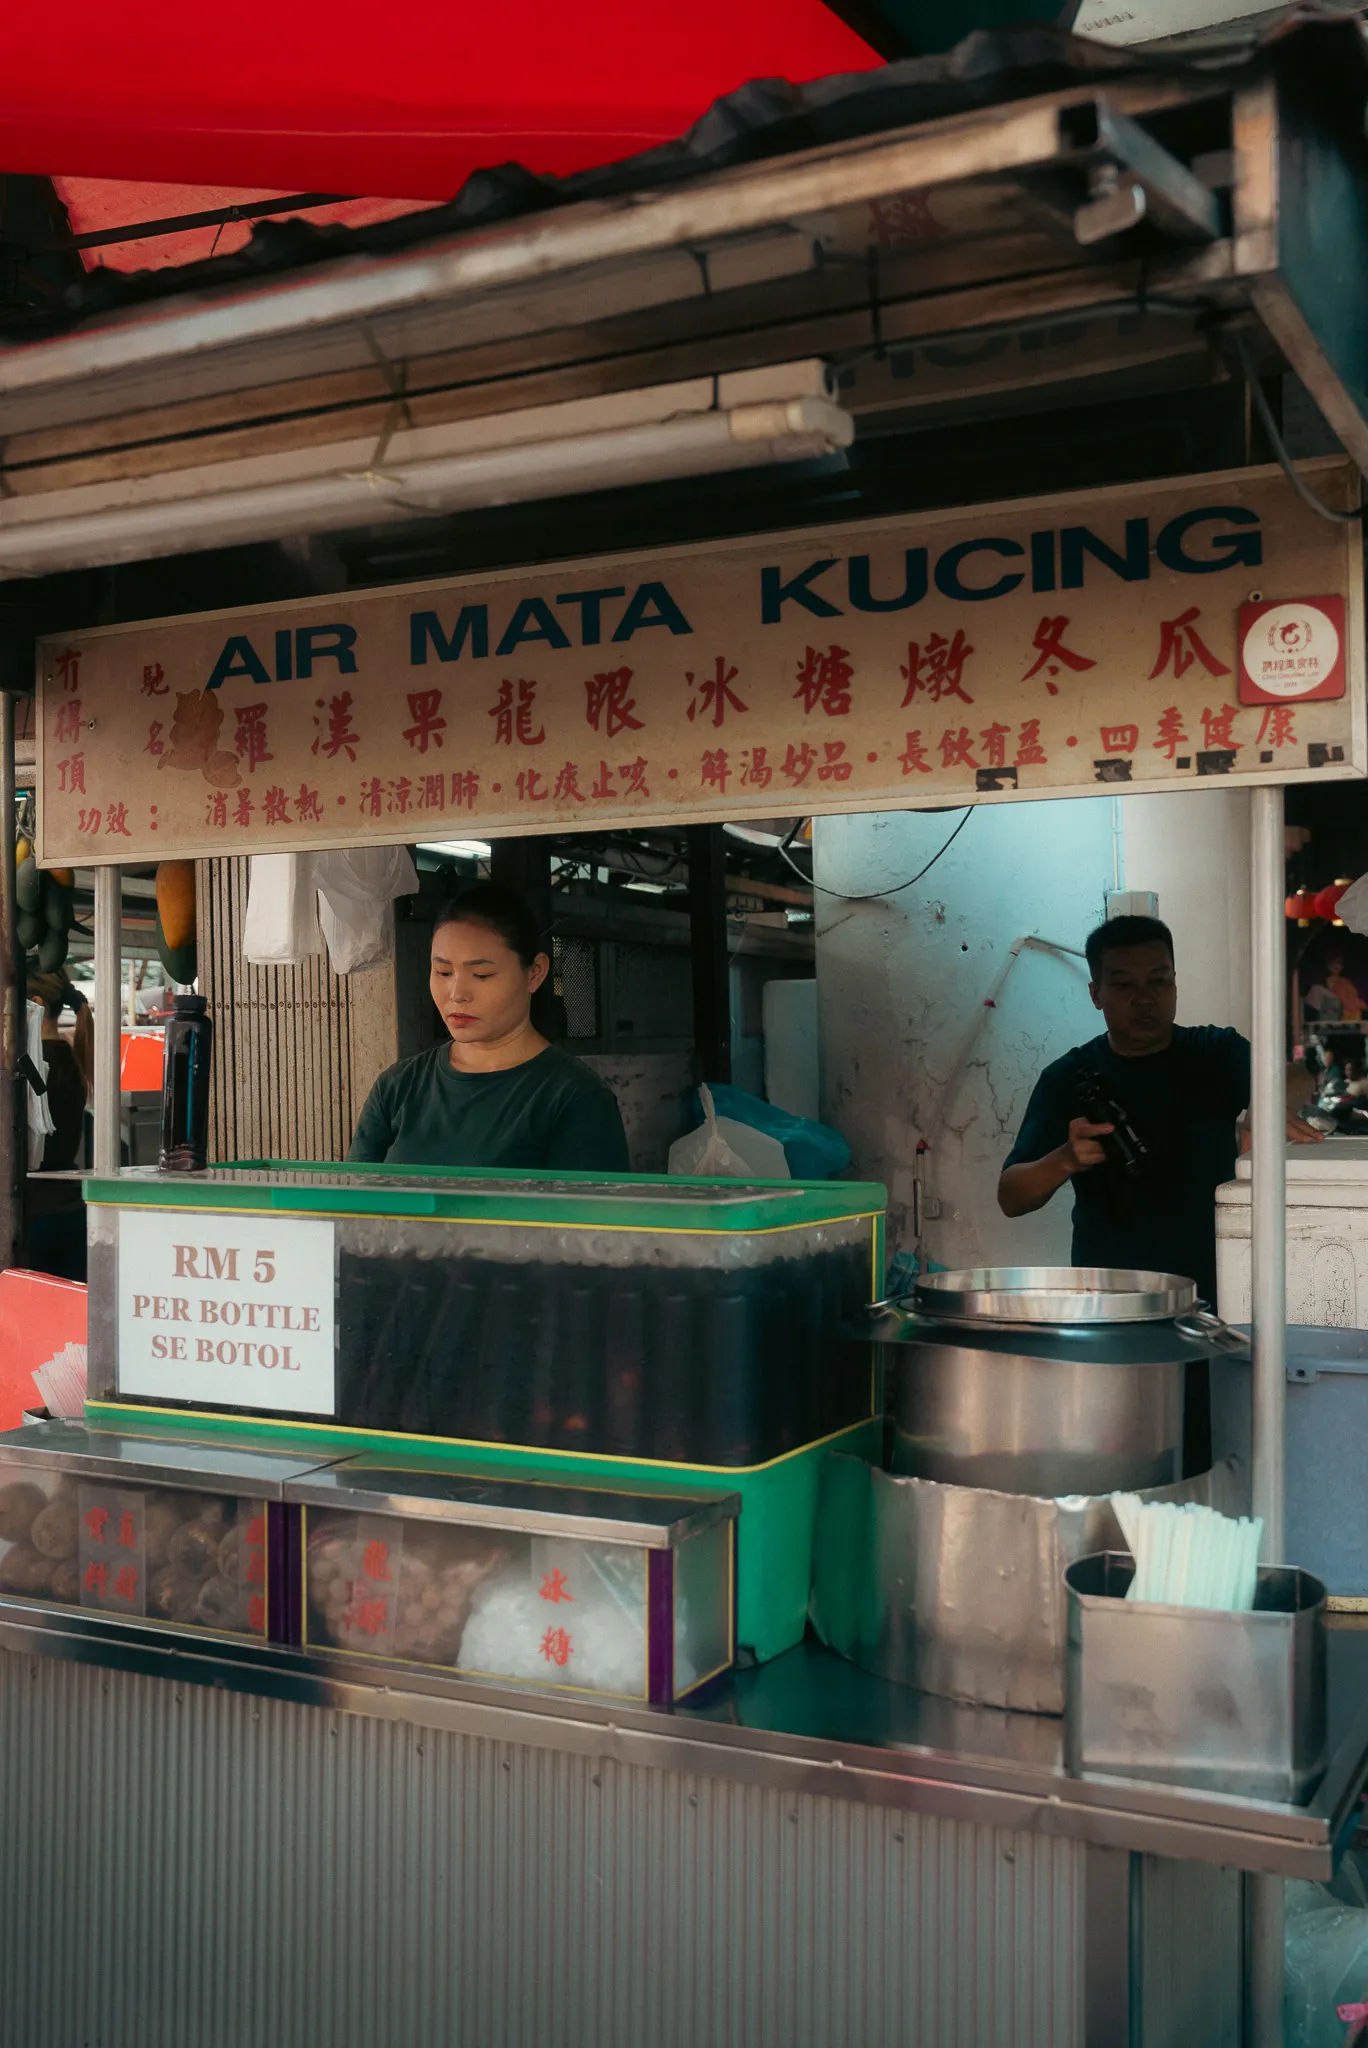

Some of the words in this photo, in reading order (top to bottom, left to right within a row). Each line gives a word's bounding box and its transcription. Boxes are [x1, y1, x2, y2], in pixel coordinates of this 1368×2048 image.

[204, 623, 358, 690] AIR
[410, 580, 694, 665] MATA
[760, 505, 1263, 624] KUCING
[54, 647, 87, 795] 冇得頂
[142, 662, 171, 756] 馳名
[172, 1244, 240, 1281] RM
[253, 1250, 275, 1283] 5
[132, 1294, 192, 1322] PER
[199, 1299, 321, 1332] BOTTLE
[151, 1334, 187, 1361] SE
[195, 1338, 300, 1371] BOTOL
